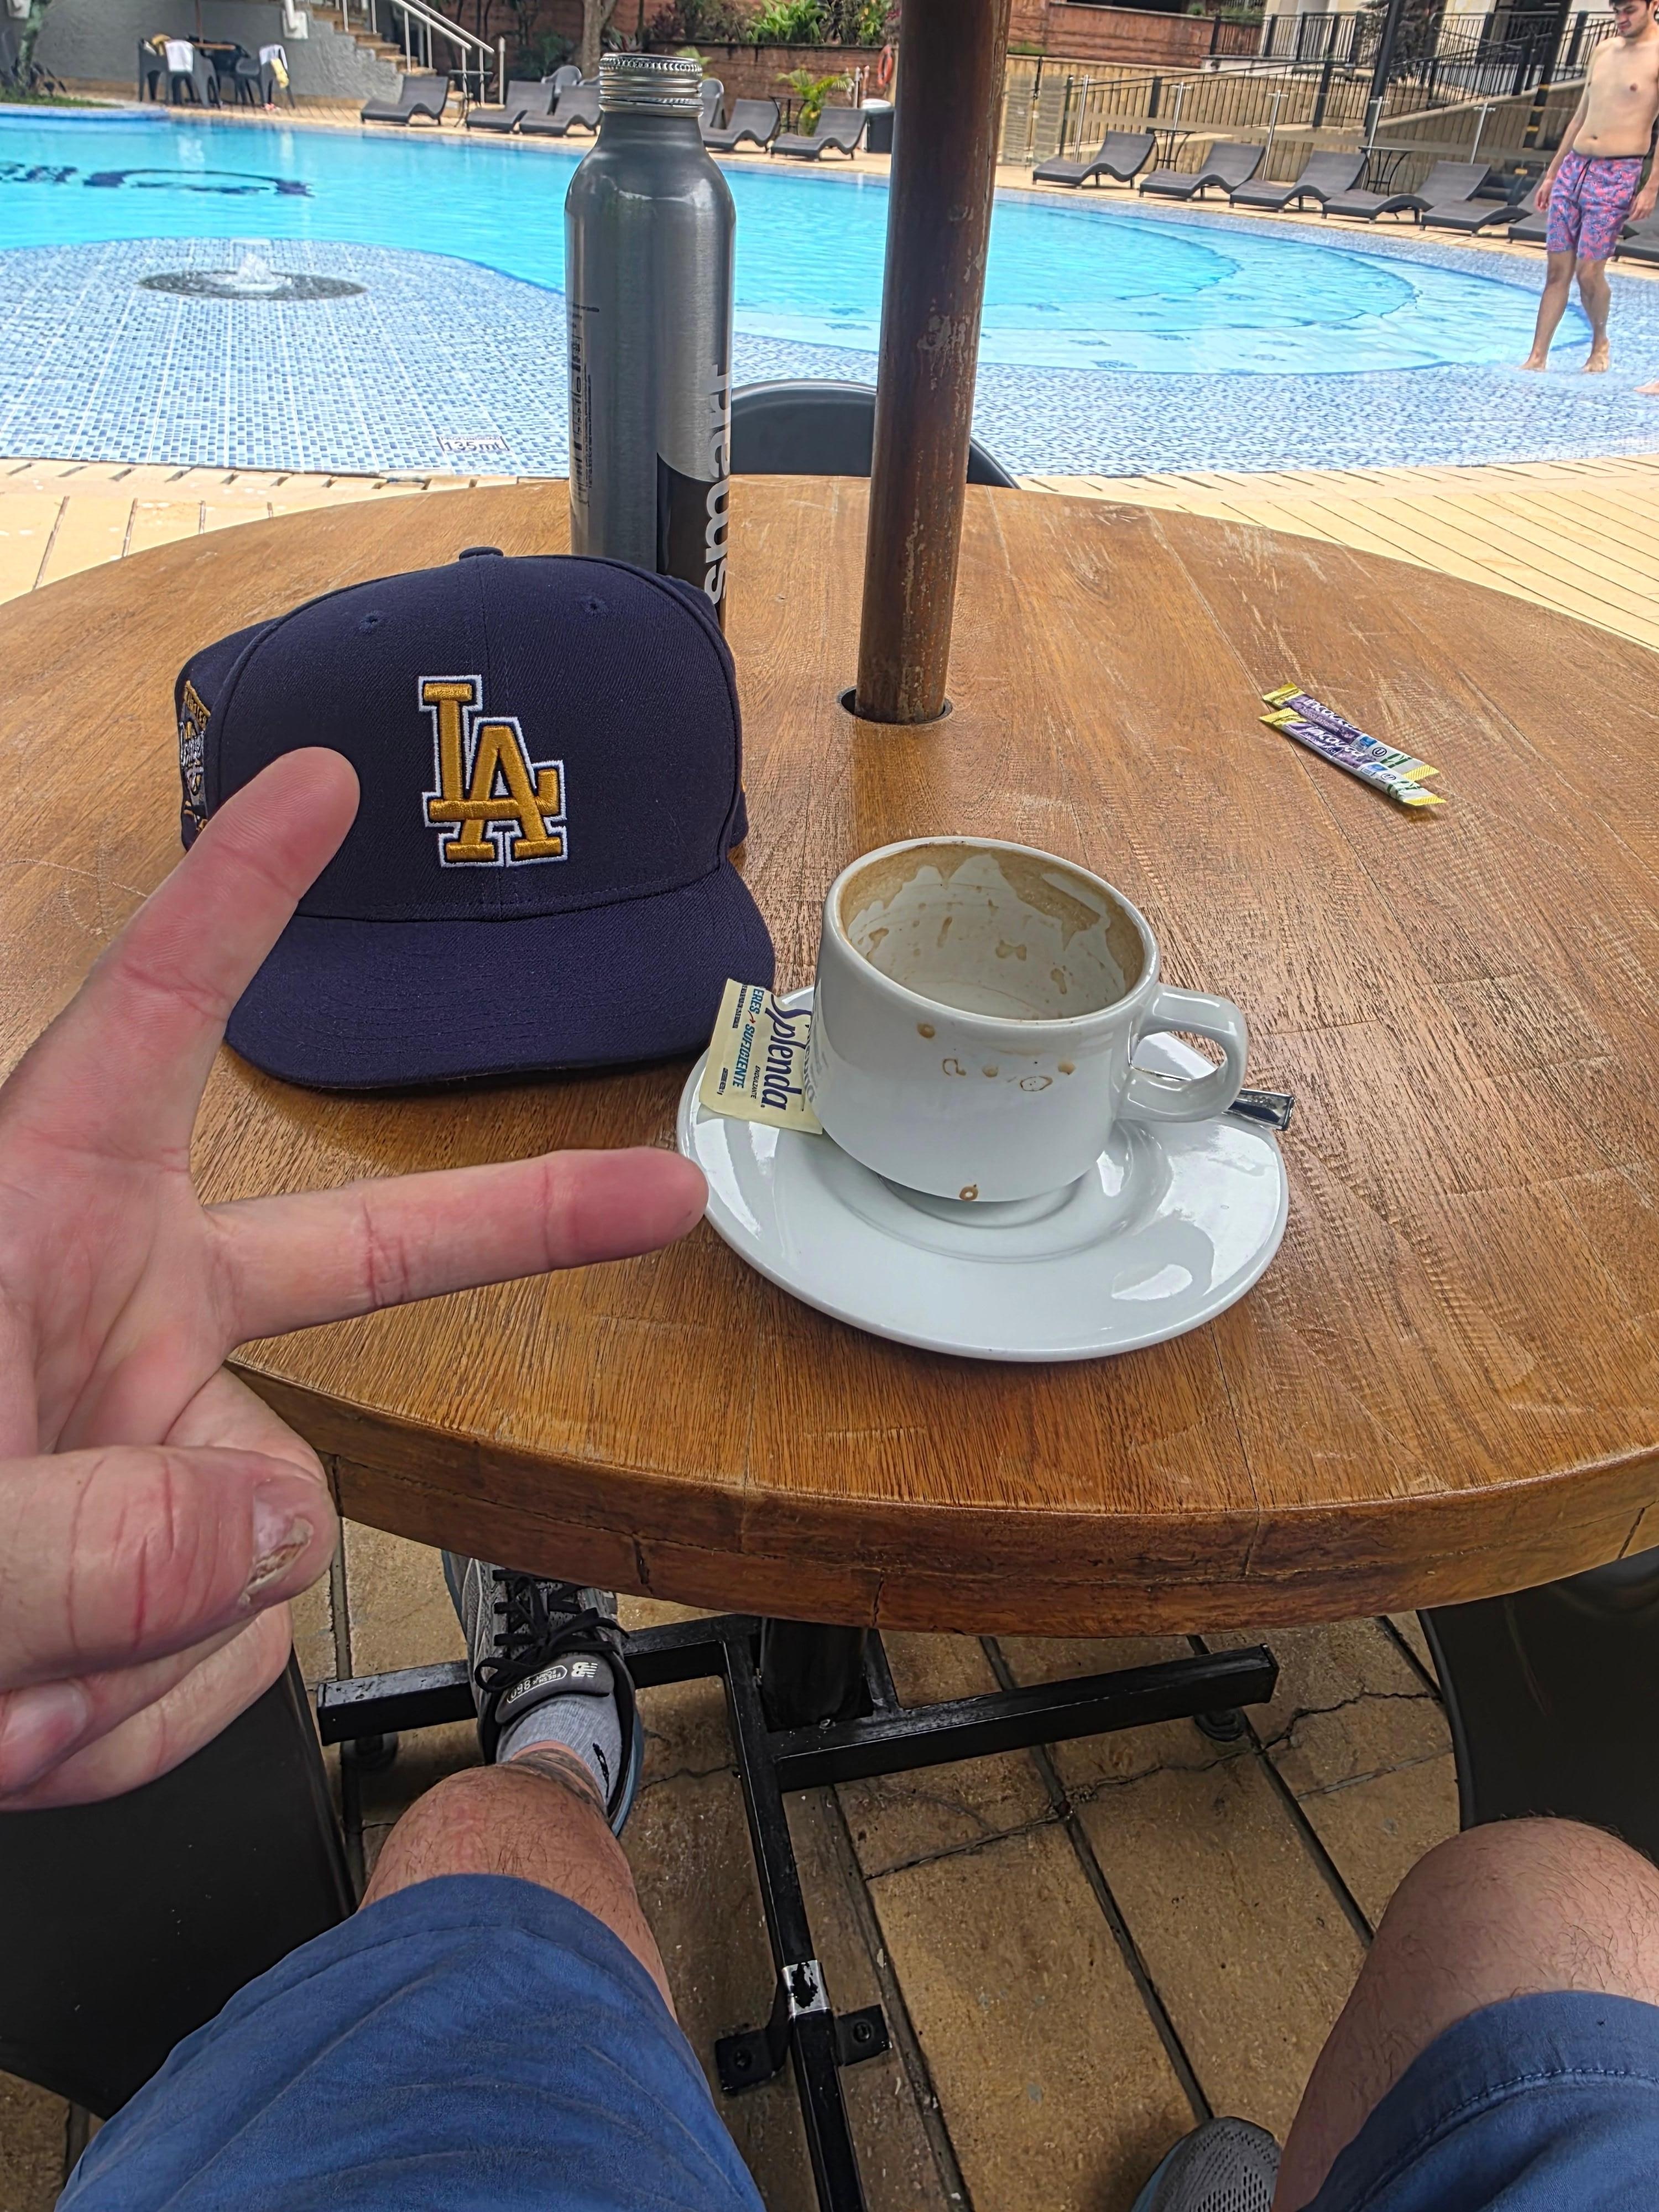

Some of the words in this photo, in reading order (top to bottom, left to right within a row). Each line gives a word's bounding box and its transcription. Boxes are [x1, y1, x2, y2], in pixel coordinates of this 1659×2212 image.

[419, 675, 568, 868] LA
[749, 988, 765, 1015] ERES
[733, 1023, 755, 1089] SUFICIENTE
[750, 1065, 761, 1099] ENDULZANTE
[761, 994, 812, 1110] Splenda
